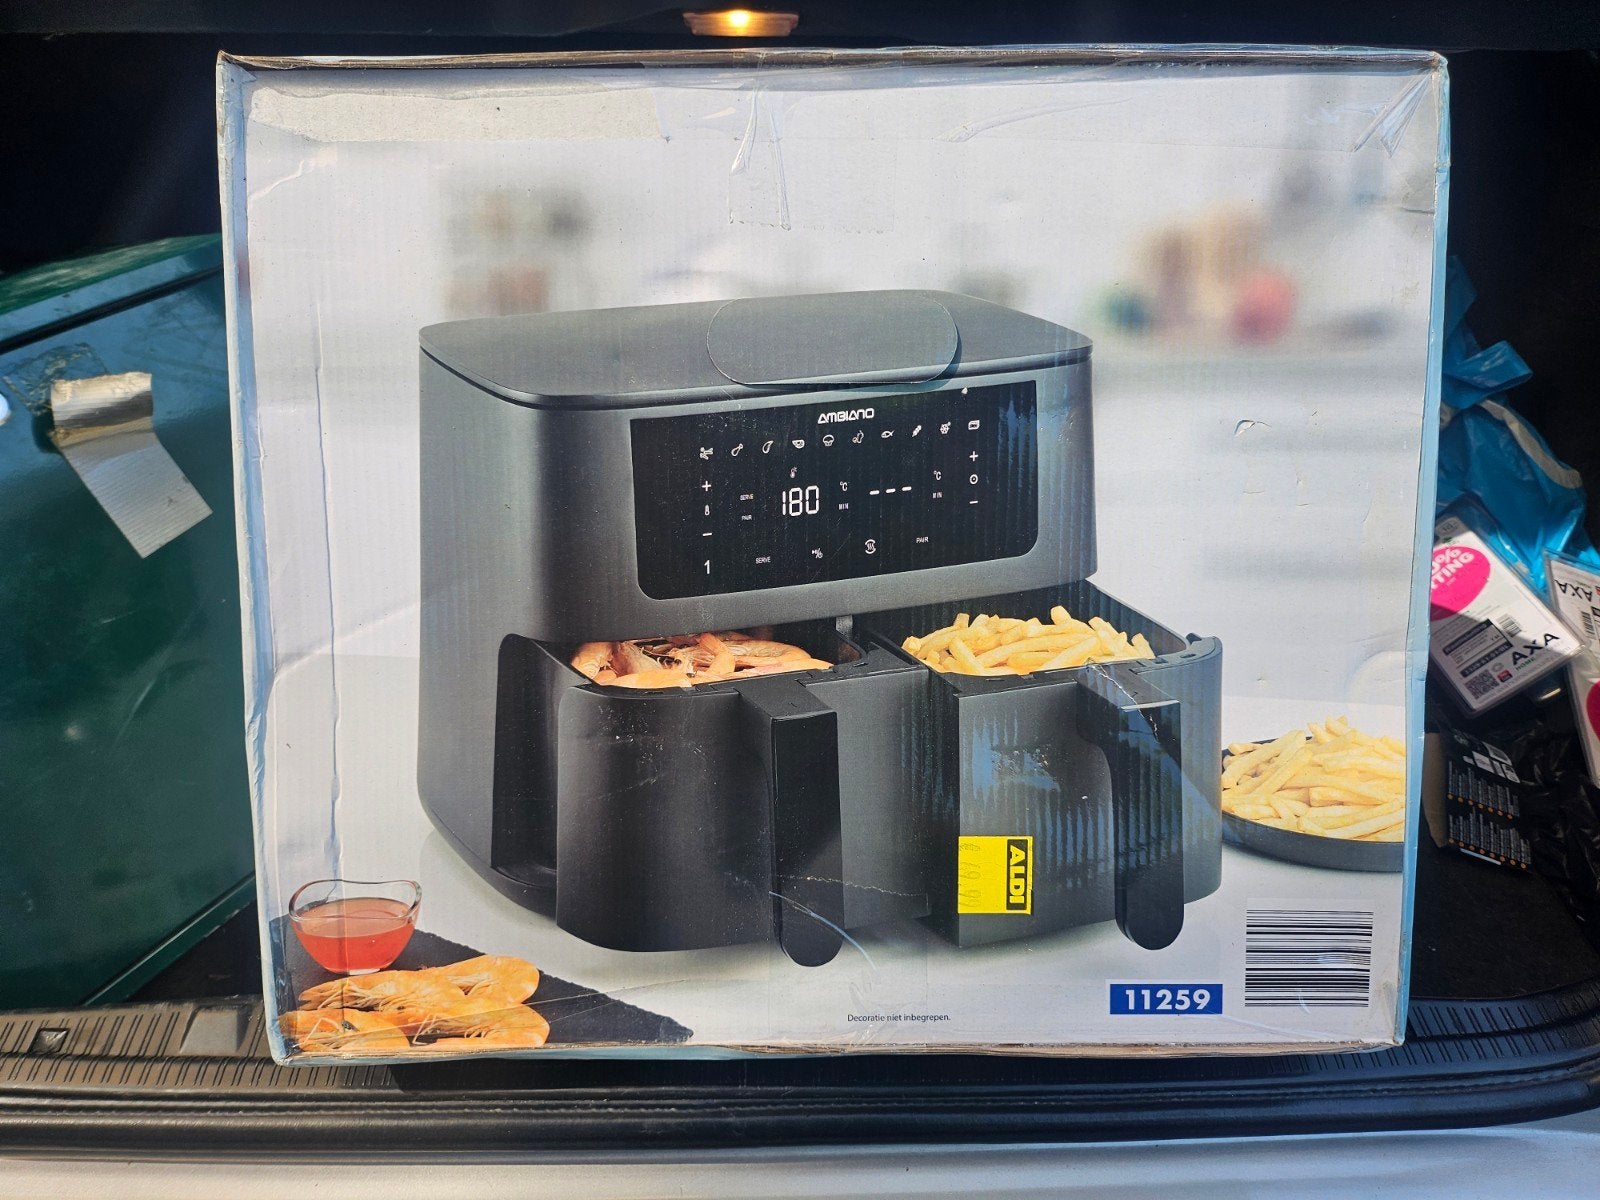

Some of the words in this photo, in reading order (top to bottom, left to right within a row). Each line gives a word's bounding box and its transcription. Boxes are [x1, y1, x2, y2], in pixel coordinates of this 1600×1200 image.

[817, 408, 875, 424] AMBIANO
[782, 485, 820, 517] 180
[915, 536, 929, 544] PAIR
[755, 556, 772, 565] SERVE
[1553, 579, 1593, 602] AXA
[1512, 633, 1560, 665] AXA
[1009, 844, 1026, 904] ALDI
[1125, 988, 1211, 1011] 11259
[847, 1014, 885, 1022] Decoratie
[903, 1014, 951, 1023] inbegrepen.
